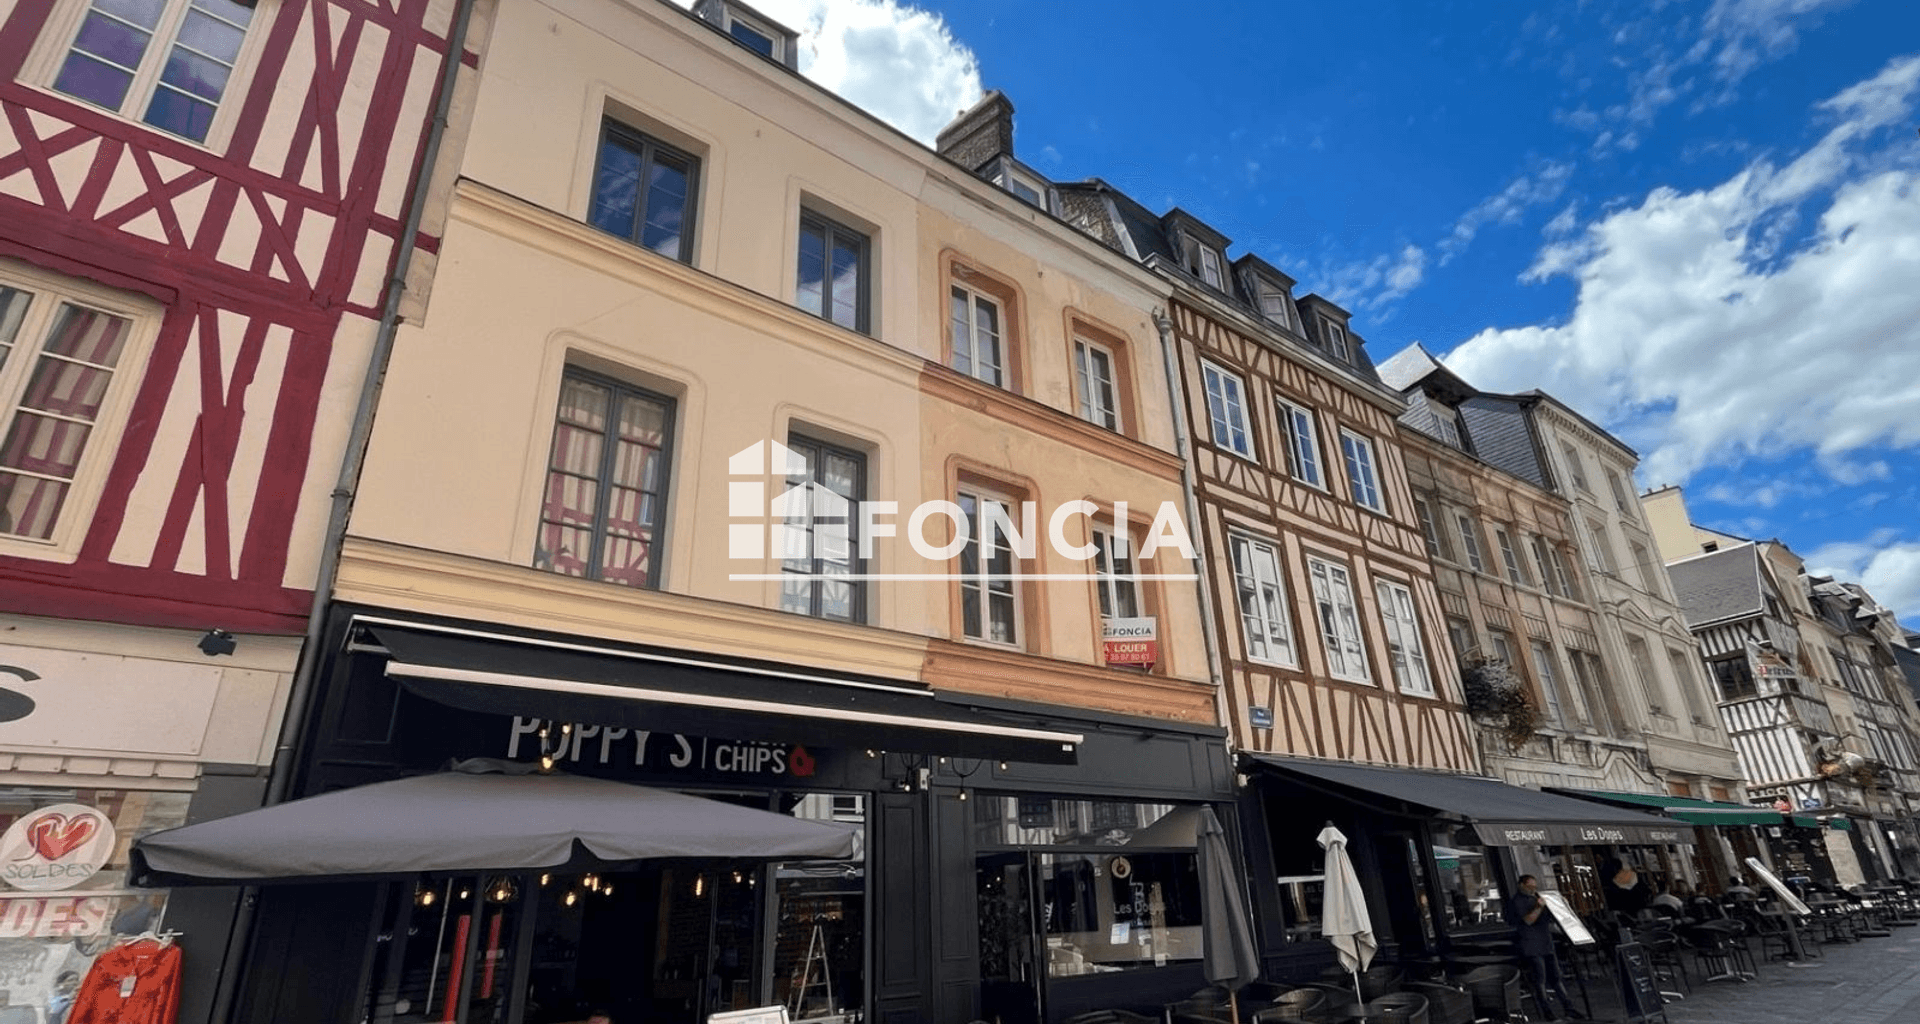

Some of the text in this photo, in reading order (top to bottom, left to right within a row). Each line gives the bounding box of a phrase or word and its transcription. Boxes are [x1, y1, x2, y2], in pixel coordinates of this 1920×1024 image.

[1113, 627, 1151, 635] FONCIA
[1114, 643, 1147, 652] LOUER
[508, 716, 692, 768] POPPYS
[715, 745, 787, 773] CHIPS
[1505, 830, 1546, 841] RESTAURANT
[1581, 827, 1598, 841] Les
[5, 863, 93, 879] SOLDES
